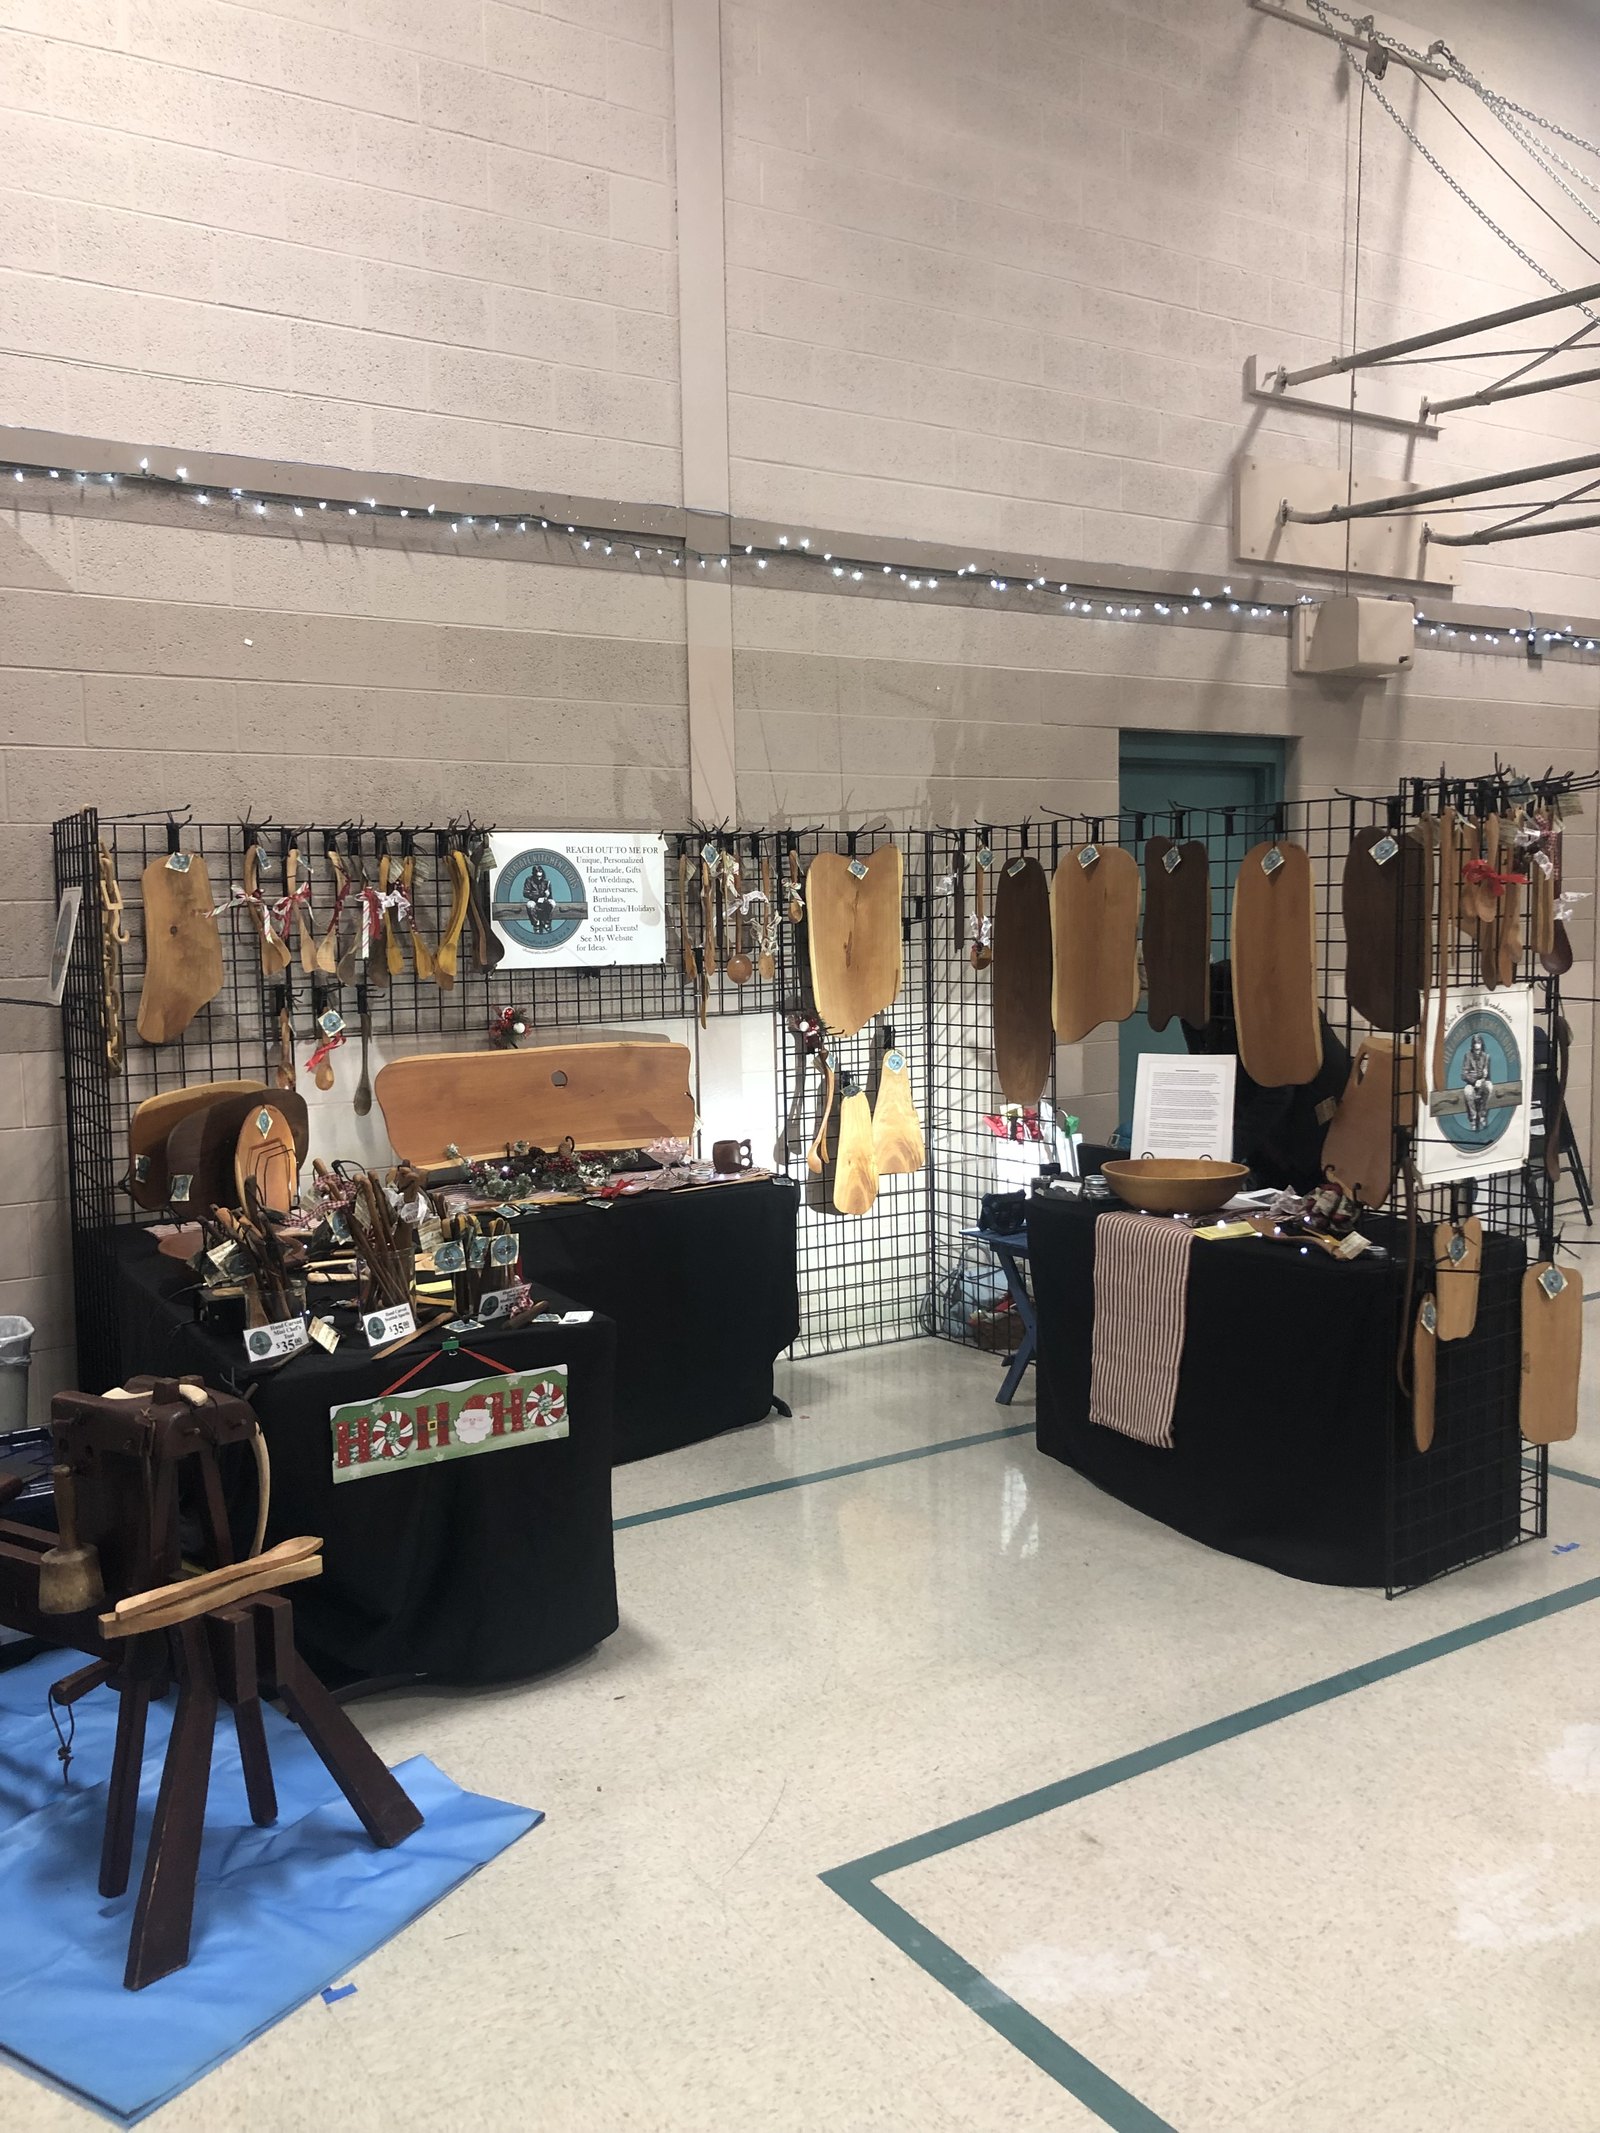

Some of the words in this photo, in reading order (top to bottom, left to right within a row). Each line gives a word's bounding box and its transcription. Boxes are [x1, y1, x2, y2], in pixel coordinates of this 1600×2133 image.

[576, 857, 602, 865] Unique,
[532, 852, 562, 869] KITCHEN
[561, 866, 579, 889] TOOLS
[600, 876, 634, 884] Weddings,
[593, 896, 626, 904] Birthdays,
[593, 905, 655, 913] Christmas/Holidays
[594, 935, 605, 943] My
[607, 934, 633, 942] Website
[269, 1323, 284, 1331] Hand
